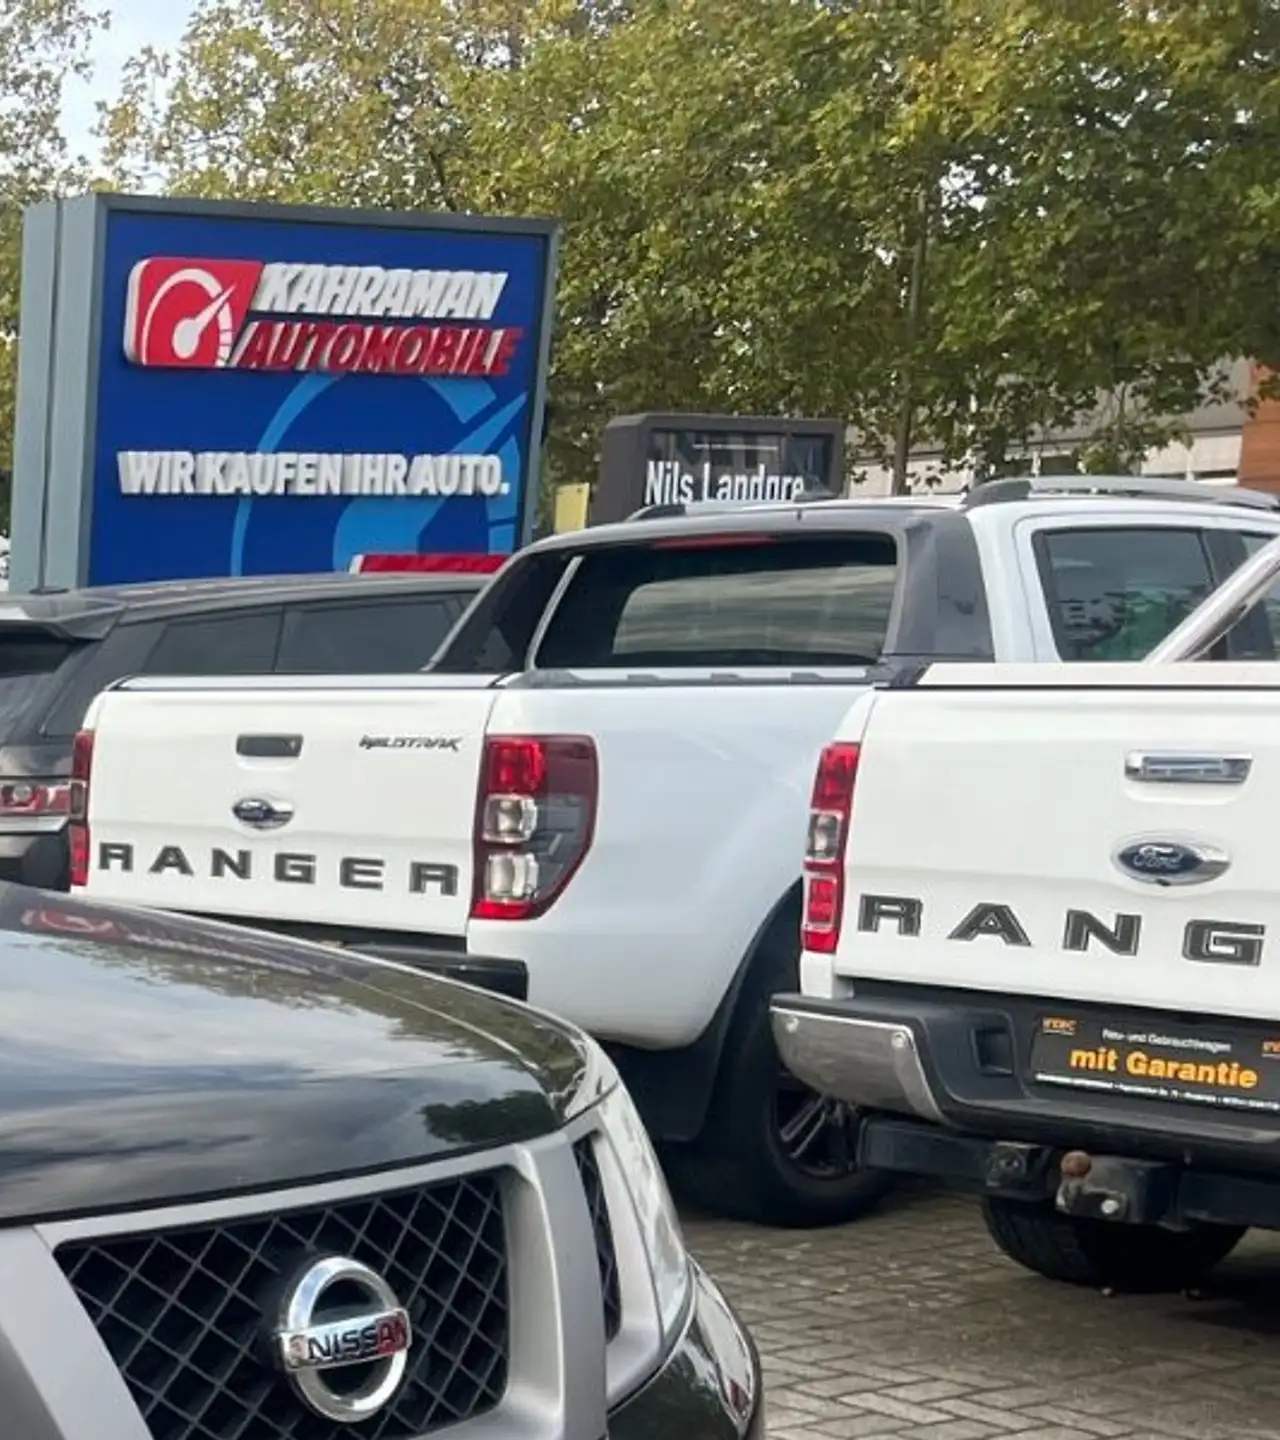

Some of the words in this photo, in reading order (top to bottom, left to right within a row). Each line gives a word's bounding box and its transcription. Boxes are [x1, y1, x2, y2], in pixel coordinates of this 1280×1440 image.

[250, 262, 509, 320] KAHRAMAN
[228, 320, 523, 377] AUTOMOBILE
[117, 451, 195, 496] WIR
[196, 452, 341, 495] KAUFEN
[341, 453, 407, 495] IHR
[407, 454, 511, 496] AUTO.
[644, 459, 694, 505] Nils
[97, 841, 459, 898] RANGER
[857, 893, 1268, 967] RANG
[1069, 1046, 1120, 1072] mit
[1125, 1050, 1258, 1088] Garantie
